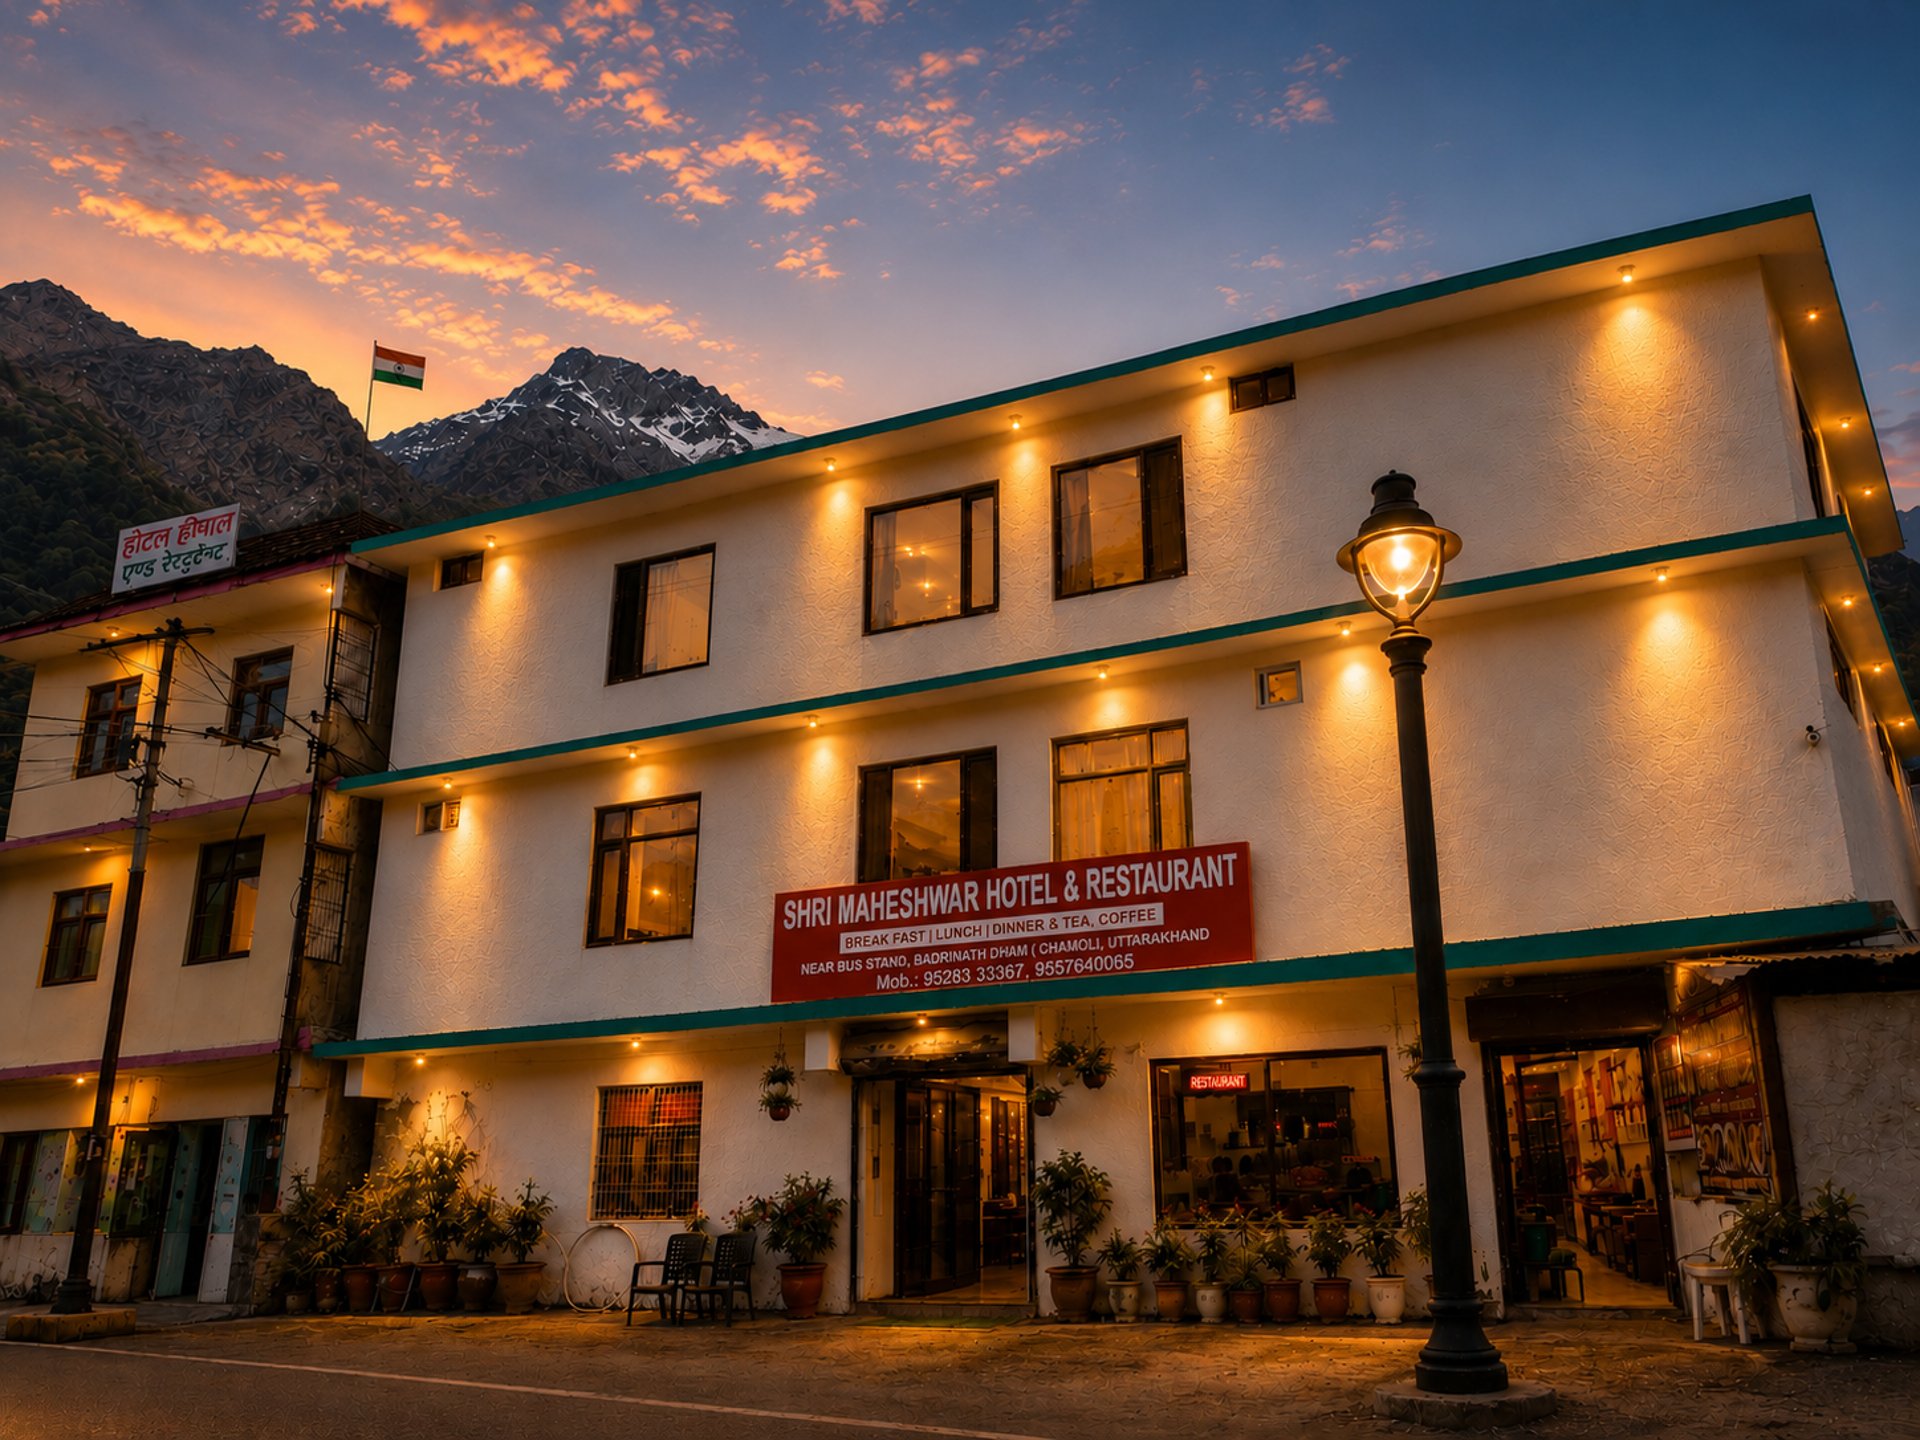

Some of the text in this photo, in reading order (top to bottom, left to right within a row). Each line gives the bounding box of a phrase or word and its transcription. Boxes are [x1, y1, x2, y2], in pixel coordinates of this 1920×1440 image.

[122, 528, 173, 559] होटल
[783, 852, 1238, 930] SHRI MAHESHWAR HOTEL & RESTAURANT
[845, 934, 889, 949] BREAK
[893, 930, 926, 944] FAST
[936, 925, 982, 940] LUNCH
[993, 919, 1044, 935] DINNER
[1049, 917, 1058, 930] &
[1099, 908, 1156, 925] COFFEE
[801, 961, 834, 975] NEAR
[837, 959, 863, 973] BUS
[914, 948, 987, 966] BADRINATH
[990, 944, 1028, 959] DHAM
[1108, 927, 1210, 948] UTTARAKHAND
[876, 973, 919, 991] Mob.:
[923, 967, 971, 987] 95283
[1035, 953, 1134, 977] 9557640065
